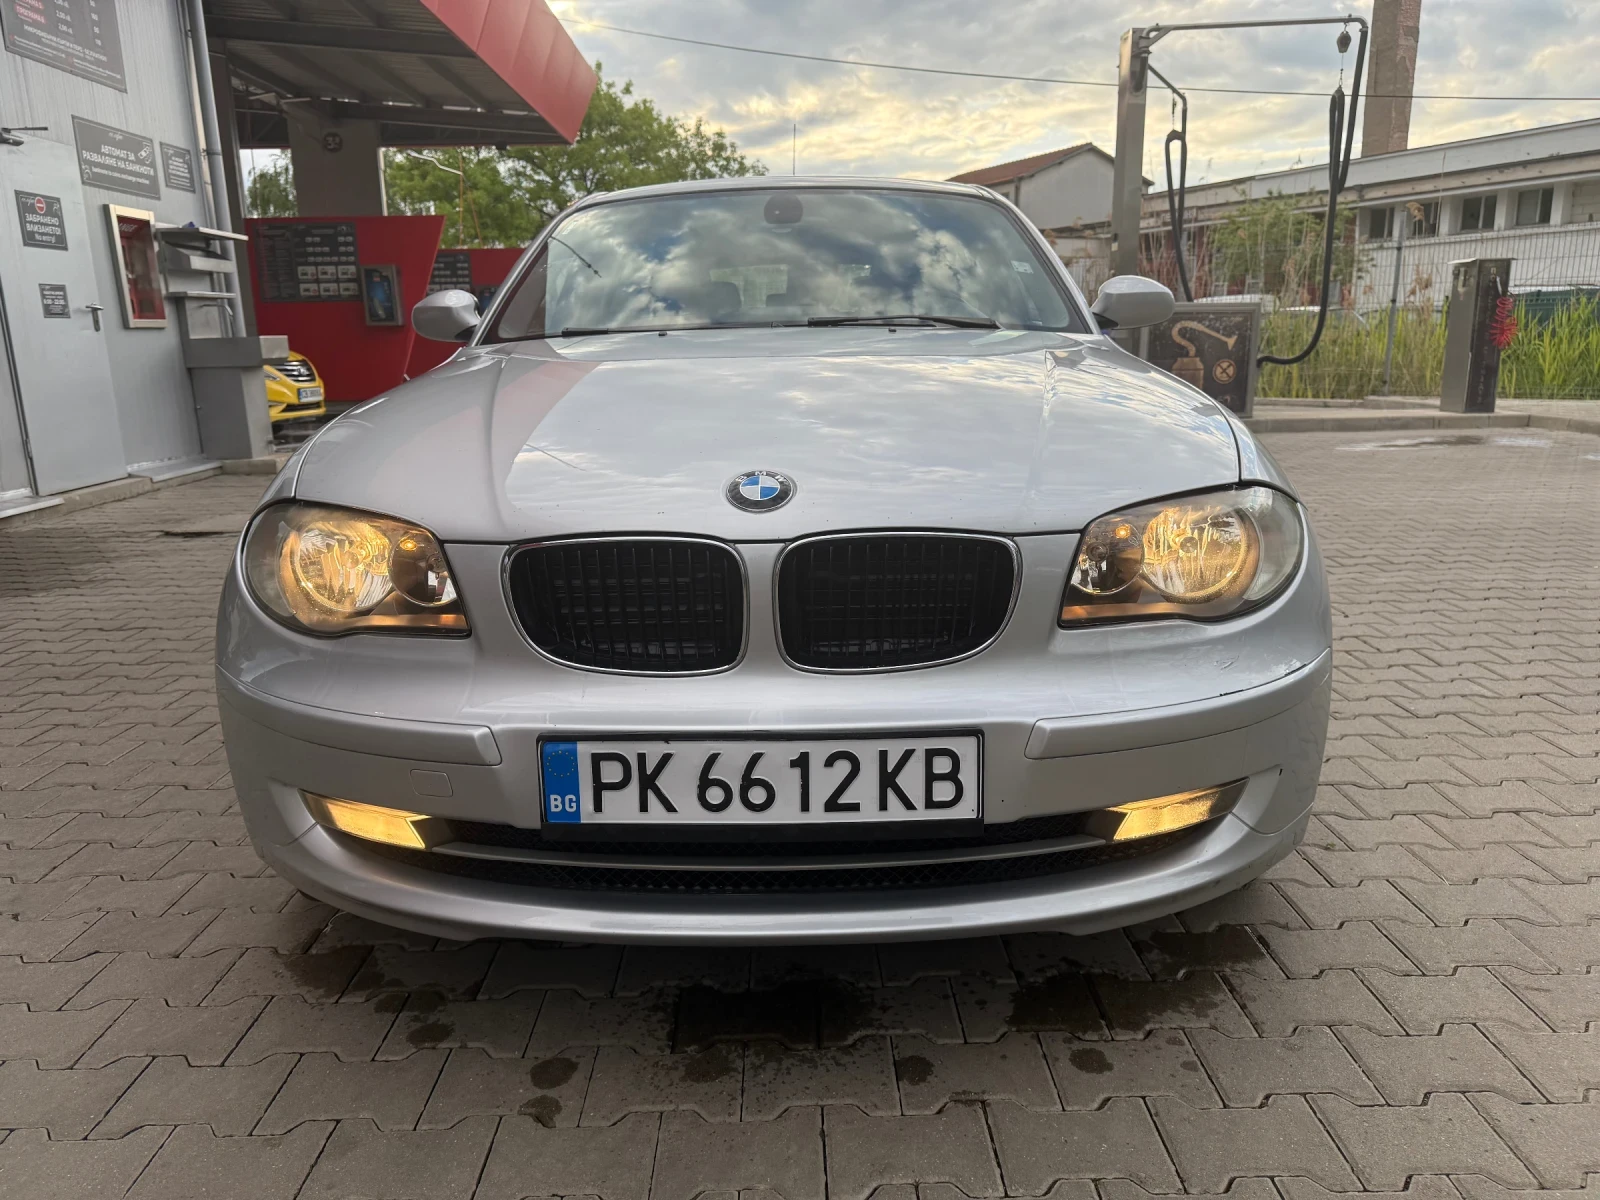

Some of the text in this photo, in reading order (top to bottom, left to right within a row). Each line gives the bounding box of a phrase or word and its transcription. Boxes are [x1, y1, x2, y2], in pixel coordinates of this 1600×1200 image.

[101, 144, 136, 161] АВТОМАТ ЗА
[82, 150, 118, 167] РАЗВАЛЯНЕ
[125, 161, 155, 176] БАНКНОТИ
[25, 213, 59, 226] ЗАБРАНЕНО
[735, 470, 788, 482] BMW
[590, 751, 679, 813] PK
[877, 747, 964, 811] KB
[550, 794, 577, 813] BG
